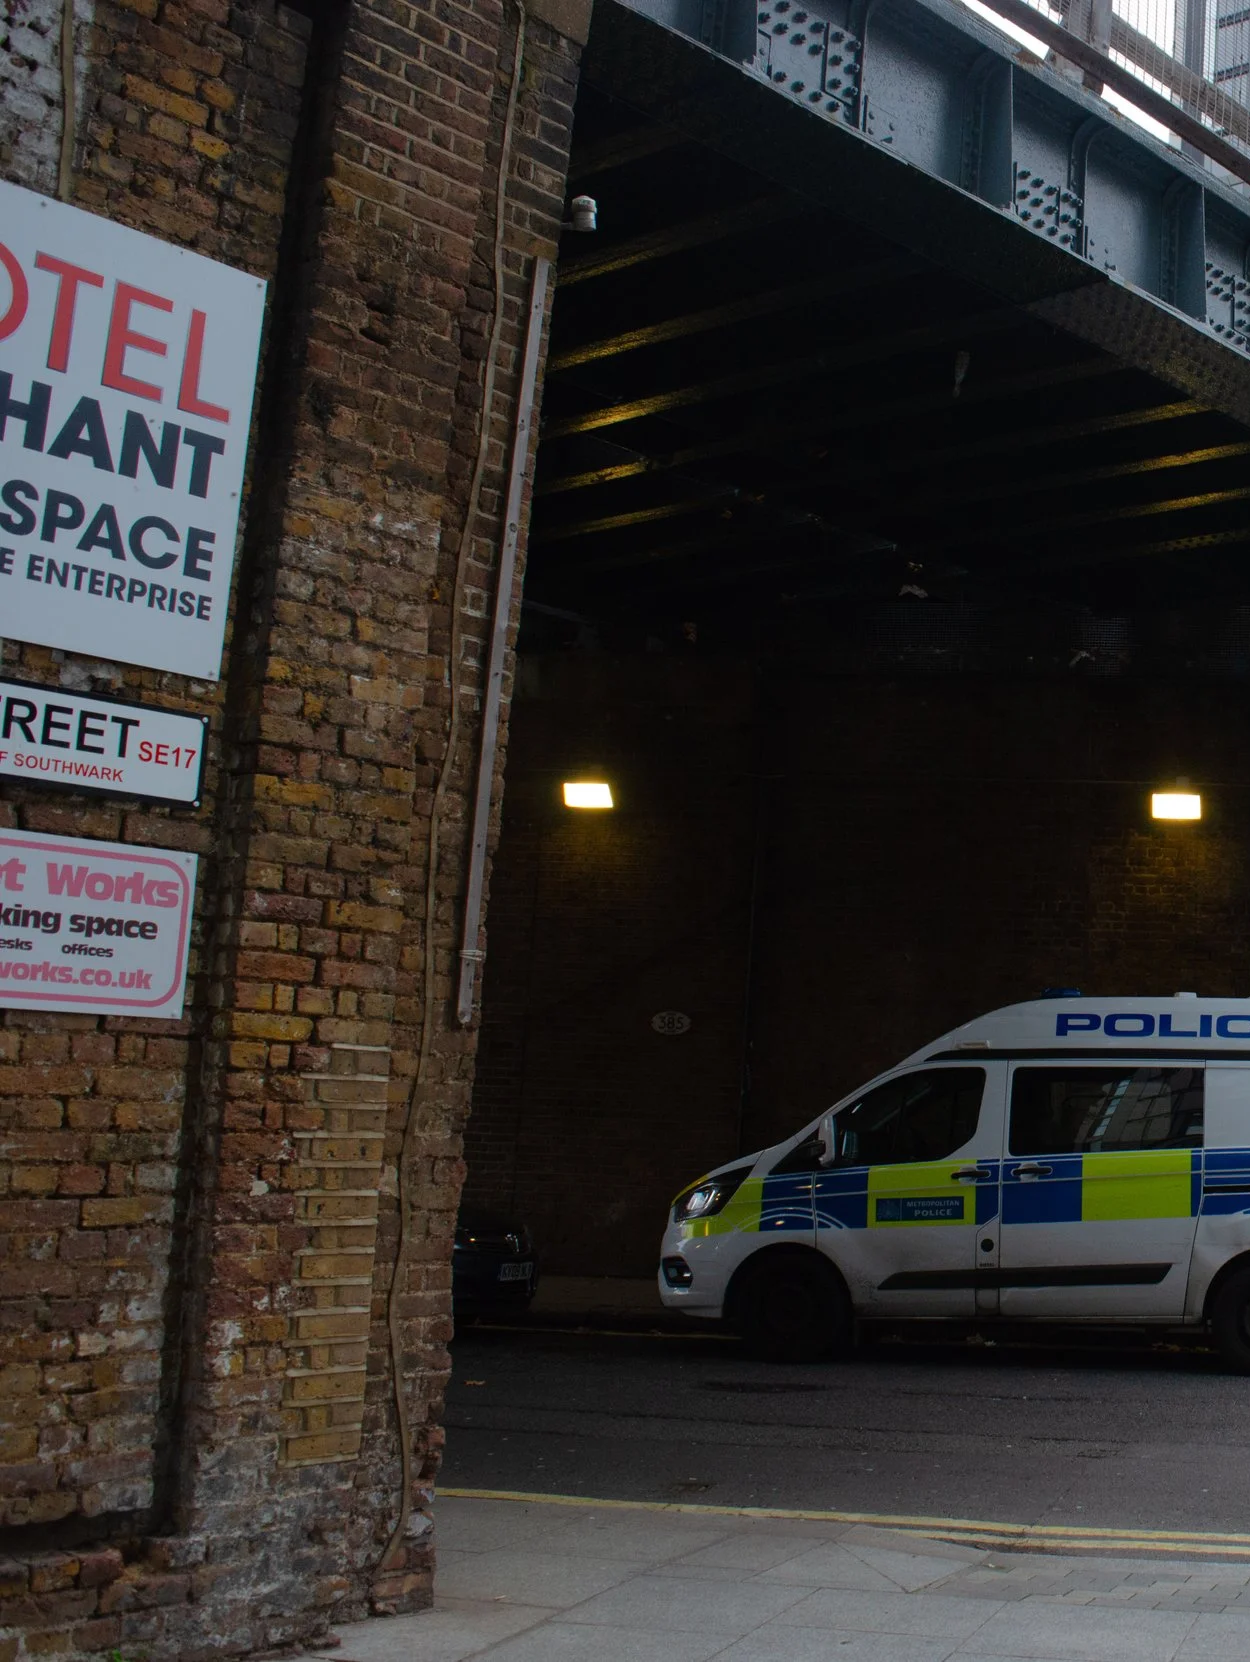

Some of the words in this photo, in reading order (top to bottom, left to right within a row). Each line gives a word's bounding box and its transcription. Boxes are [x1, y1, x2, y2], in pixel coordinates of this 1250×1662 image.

[0, 370, 226, 499] HANT
[0, 479, 216, 582] SPACE
[0, 547, 15, 575] E
[27, 554, 213, 621] ENTERPRISE
[0, 695, 141, 758] REET
[138, 741, 197, 769] SE17
[14, 753, 124, 783] SOUTHWARK
[0, 858, 26, 891] t
[46, 862, 180, 908] Works
[0, 902, 62, 934] king
[69, 914, 158, 940] space
[0, 938, 33, 951] esks
[61, 944, 114, 958] offices
[658, 1015, 684, 1029] 385
[906, 1199, 960, 1207] METROPOLITAN
[914, 1208, 953, 1217] POLICE
